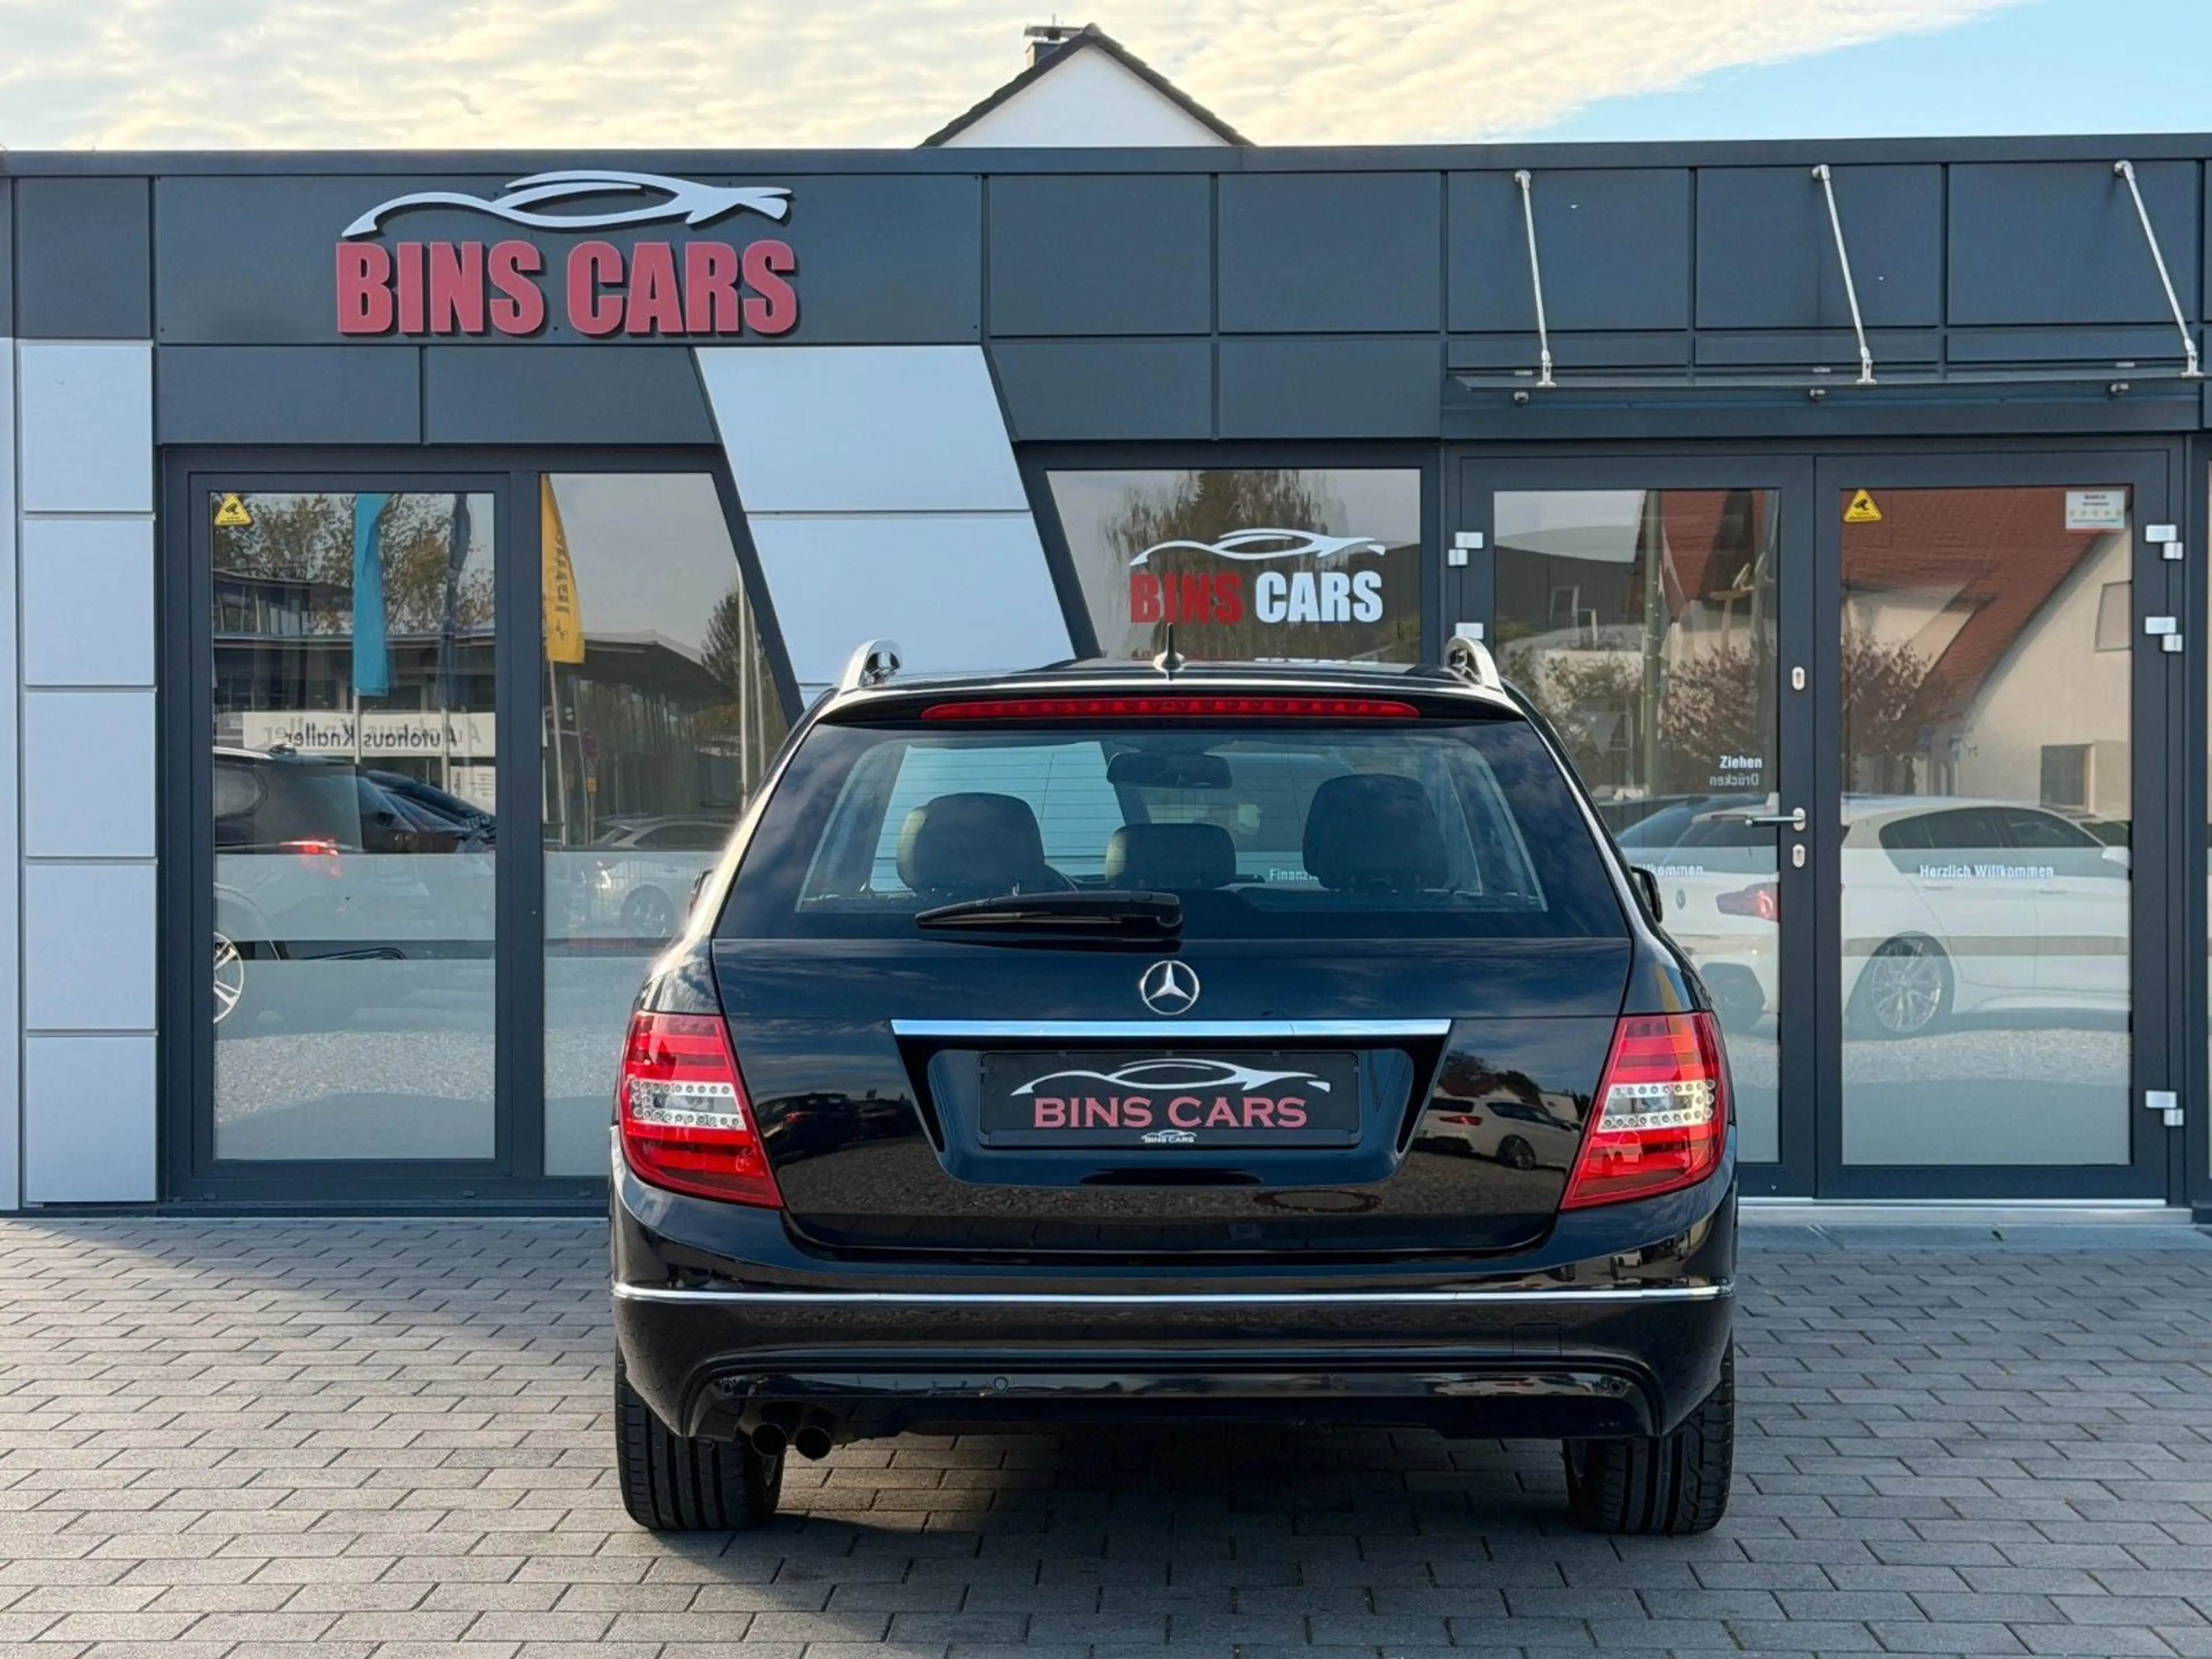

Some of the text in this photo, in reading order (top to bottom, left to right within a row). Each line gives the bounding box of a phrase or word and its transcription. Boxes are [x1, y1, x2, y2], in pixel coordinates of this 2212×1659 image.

[336, 241, 798, 335] BINS CARS
[1130, 571, 1384, 624] BINS CARS
[1719, 755, 1763, 769] Ziehen
[1919, 864, 2054, 879] Herzlich Willkommen
[1035, 1097, 1308, 1128] BINS CARS
